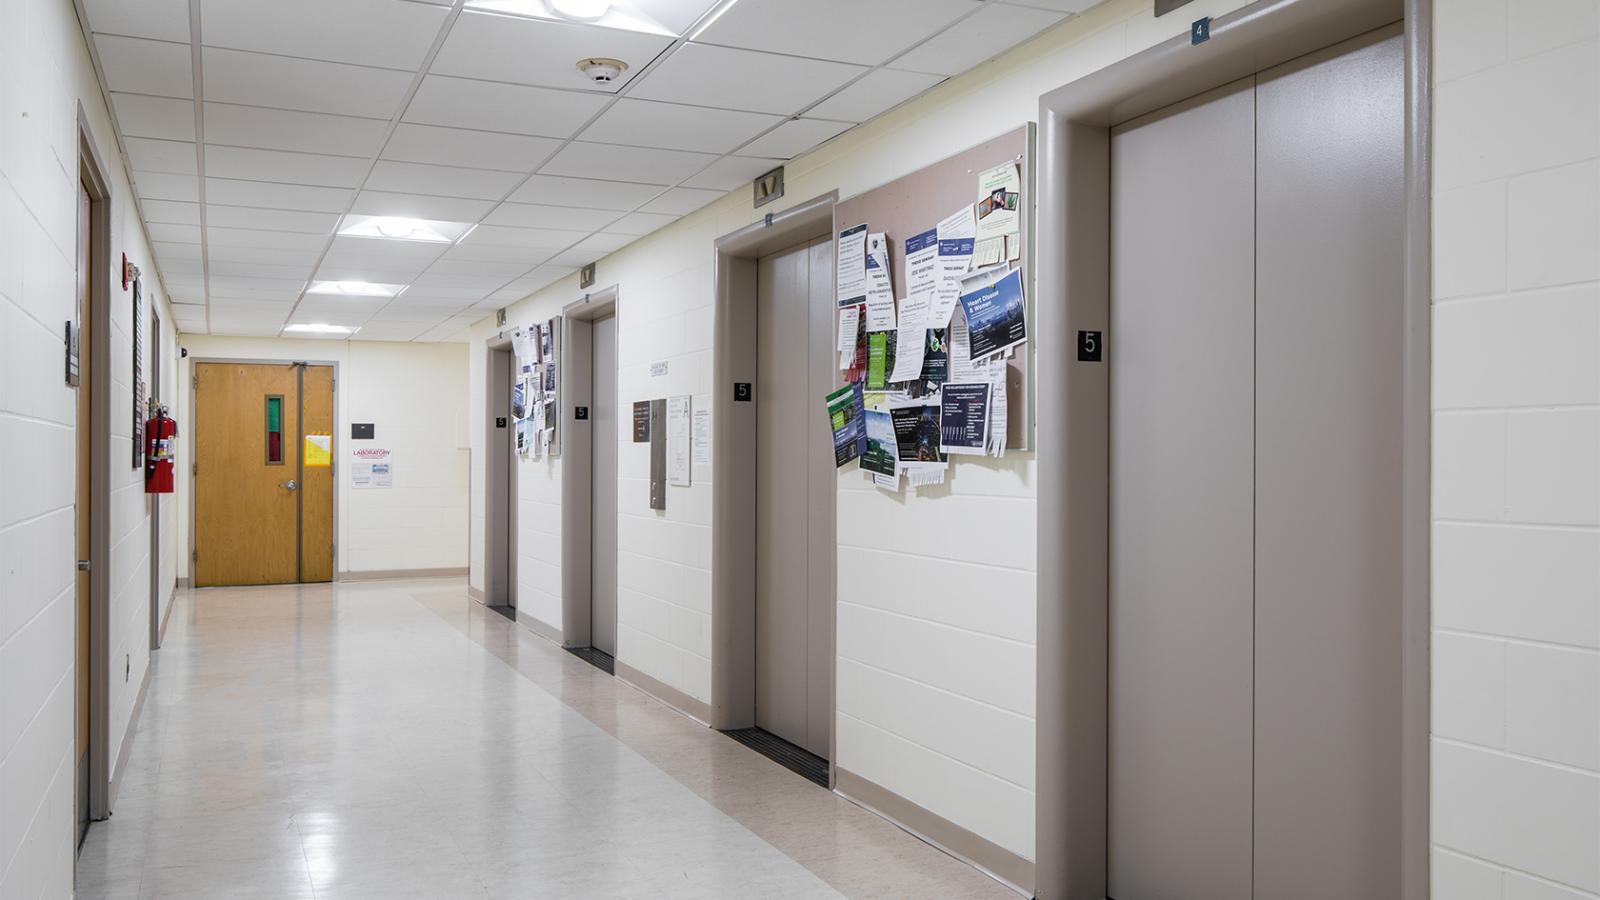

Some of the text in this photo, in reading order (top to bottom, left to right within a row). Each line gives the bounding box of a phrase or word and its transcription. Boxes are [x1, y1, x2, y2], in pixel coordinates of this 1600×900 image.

[1196, 24, 1203, 36] 4
[967, 297, 982, 307] Heart
[1085, 332, 1096, 353] 5
[738, 383, 747, 397] 5
[578, 407, 585, 417] 5
[498, 418, 504, 426] 5
